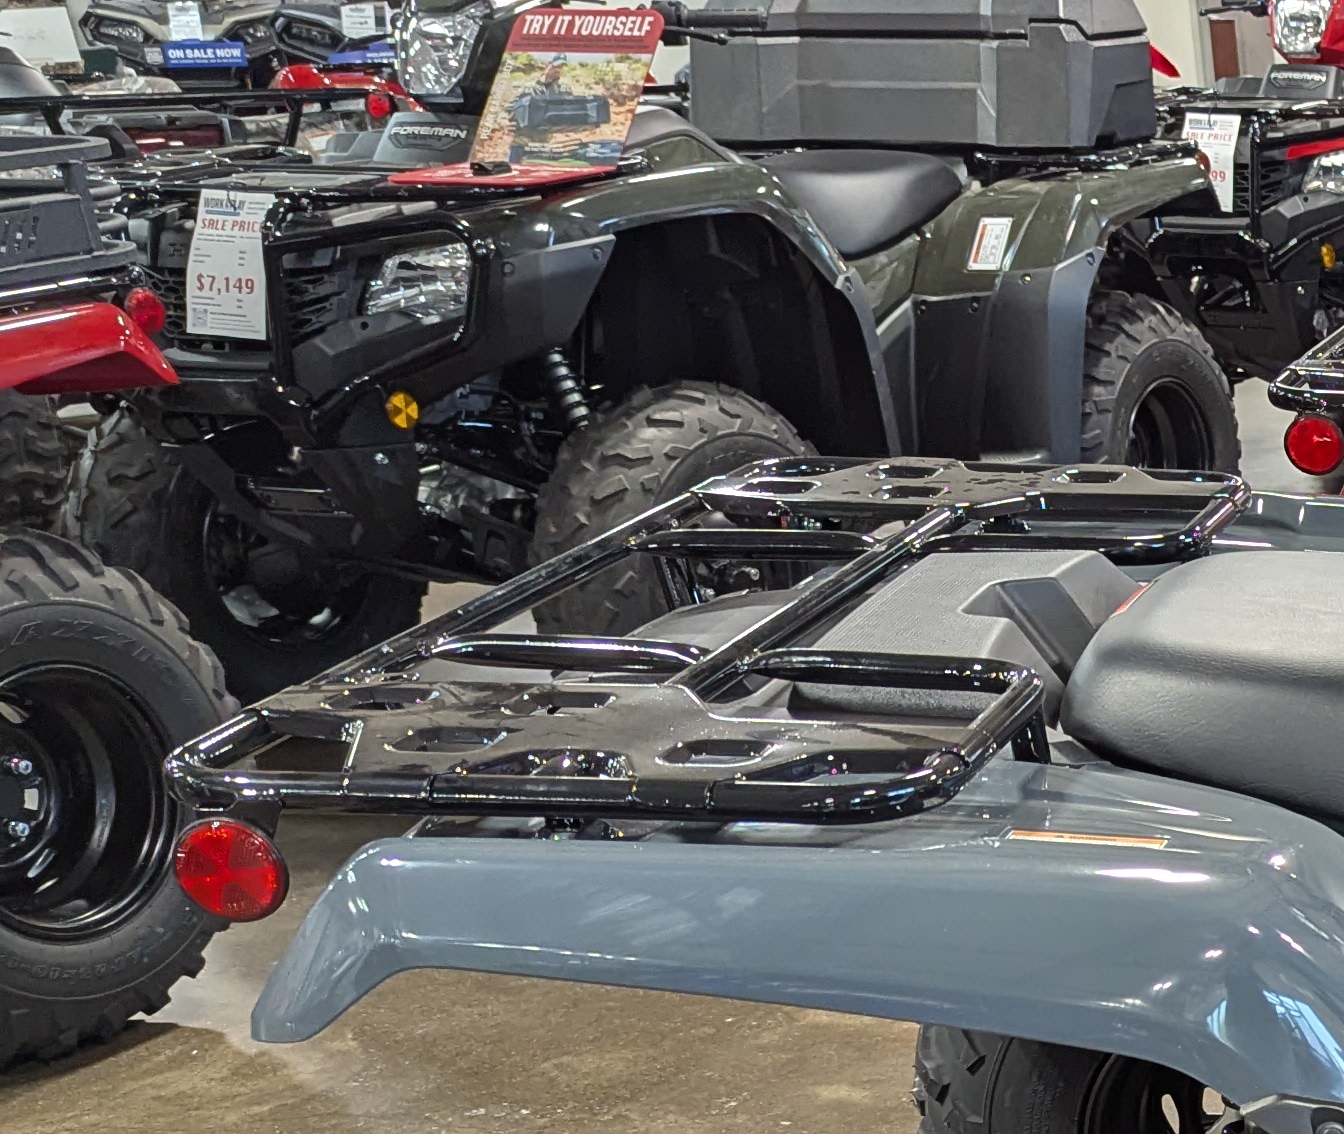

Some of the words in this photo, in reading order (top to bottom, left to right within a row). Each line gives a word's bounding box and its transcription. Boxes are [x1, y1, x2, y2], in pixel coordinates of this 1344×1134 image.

[522, 15, 556, 35] TRY
[553, 15, 571, 35] IT
[572, 15, 654, 37] YOURSELF
[168, 49, 183, 59] ON
[185, 49, 214, 59] SALE
[216, 48, 241, 58] NOW
[1270, 71, 1327, 83] FOREMAN
[391, 126, 467, 139] FOREMAN
[1207, 132, 1234, 141] PRICE
[201, 218, 228, 231] SALE
[196, 272, 255, 295] $7,149
